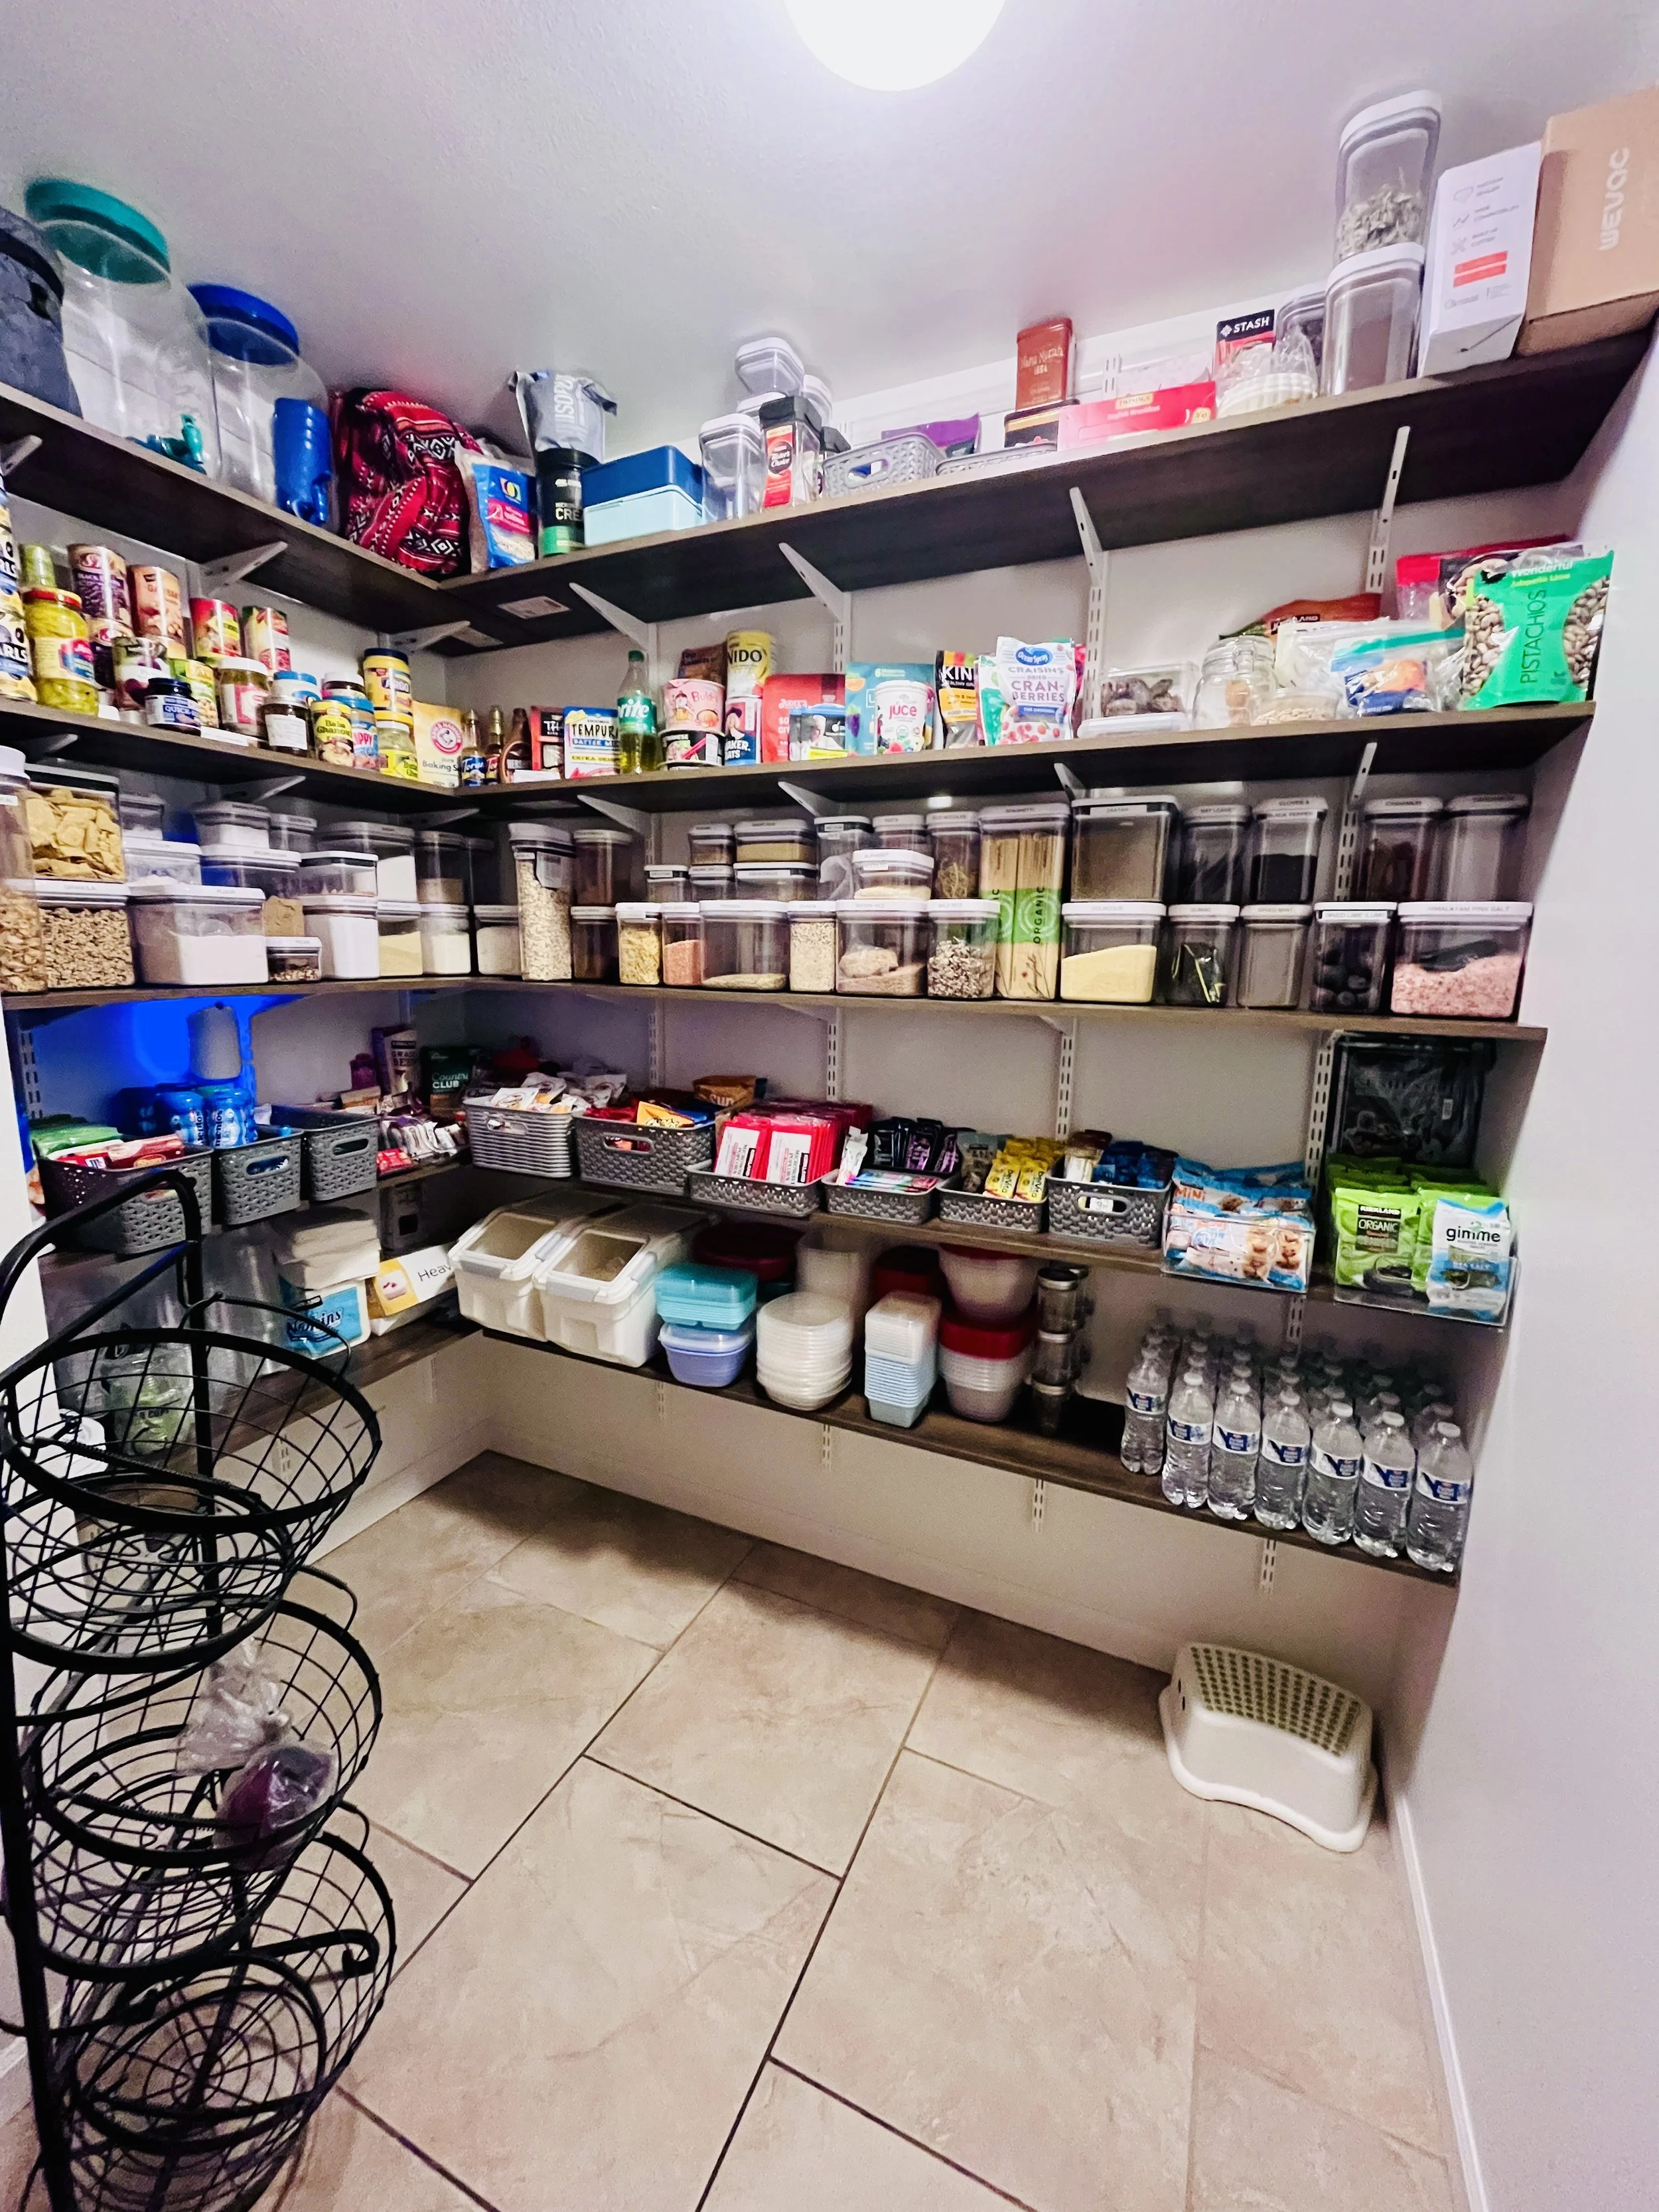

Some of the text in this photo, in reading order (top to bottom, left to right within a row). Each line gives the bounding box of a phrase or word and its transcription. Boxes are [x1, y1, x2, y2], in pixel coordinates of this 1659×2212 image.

[1234, 316, 1270, 333] STASH
[1520, 589, 1547, 684] PISTACHIOS
[1011, 680, 1064, 692] CRAN-
[1012, 692, 1065, 702] BERRIES
[422, 761, 451, 773] Baking
[1033, 886, 1045, 944] ORGANIC
[433, 1080, 459, 1089] CLUB
[1360, 1205, 1401, 1215] KIRKLAND
[1358, 1218, 1398, 1231] ORGANIC
[1446, 1226, 1501, 1243] gimme
